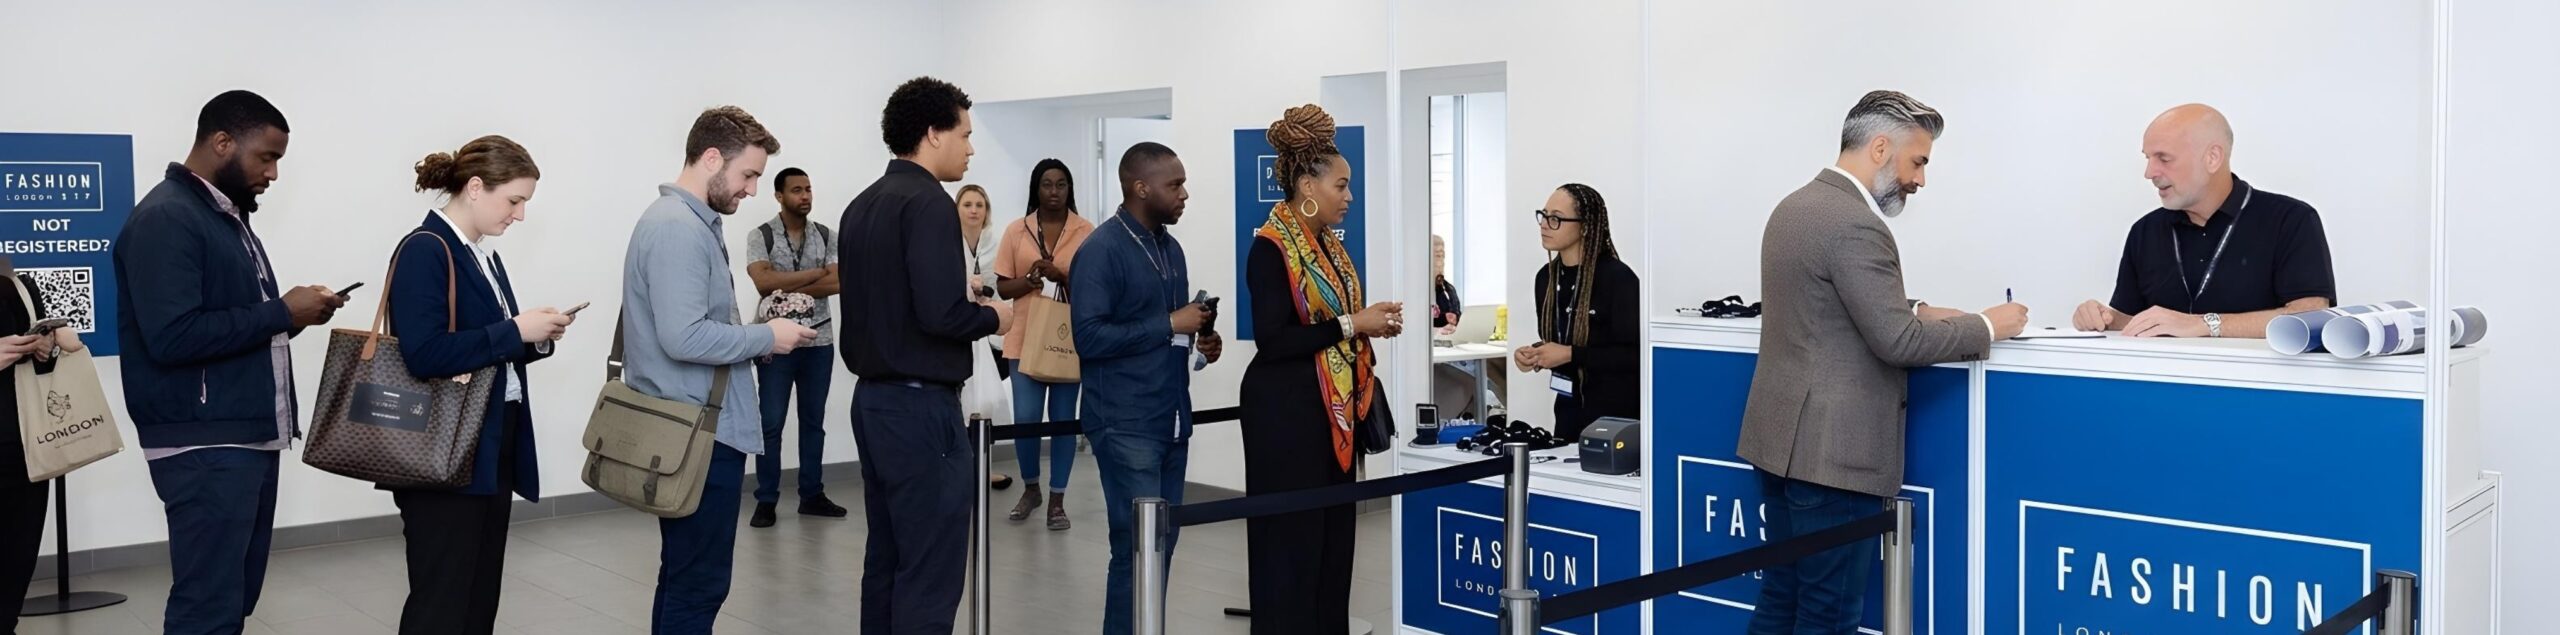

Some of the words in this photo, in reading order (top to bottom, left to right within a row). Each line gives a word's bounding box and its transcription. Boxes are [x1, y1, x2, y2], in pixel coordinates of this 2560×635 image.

[6, 174, 90, 188] FASHION
[33, 219, 71, 231] NOT
[36, 415, 104, 444] LONDON
[1455, 533, 1577, 586] FASION
[1456, 578, 1503, 596] LOND
[2058, 546, 2322, 632] FASHION
